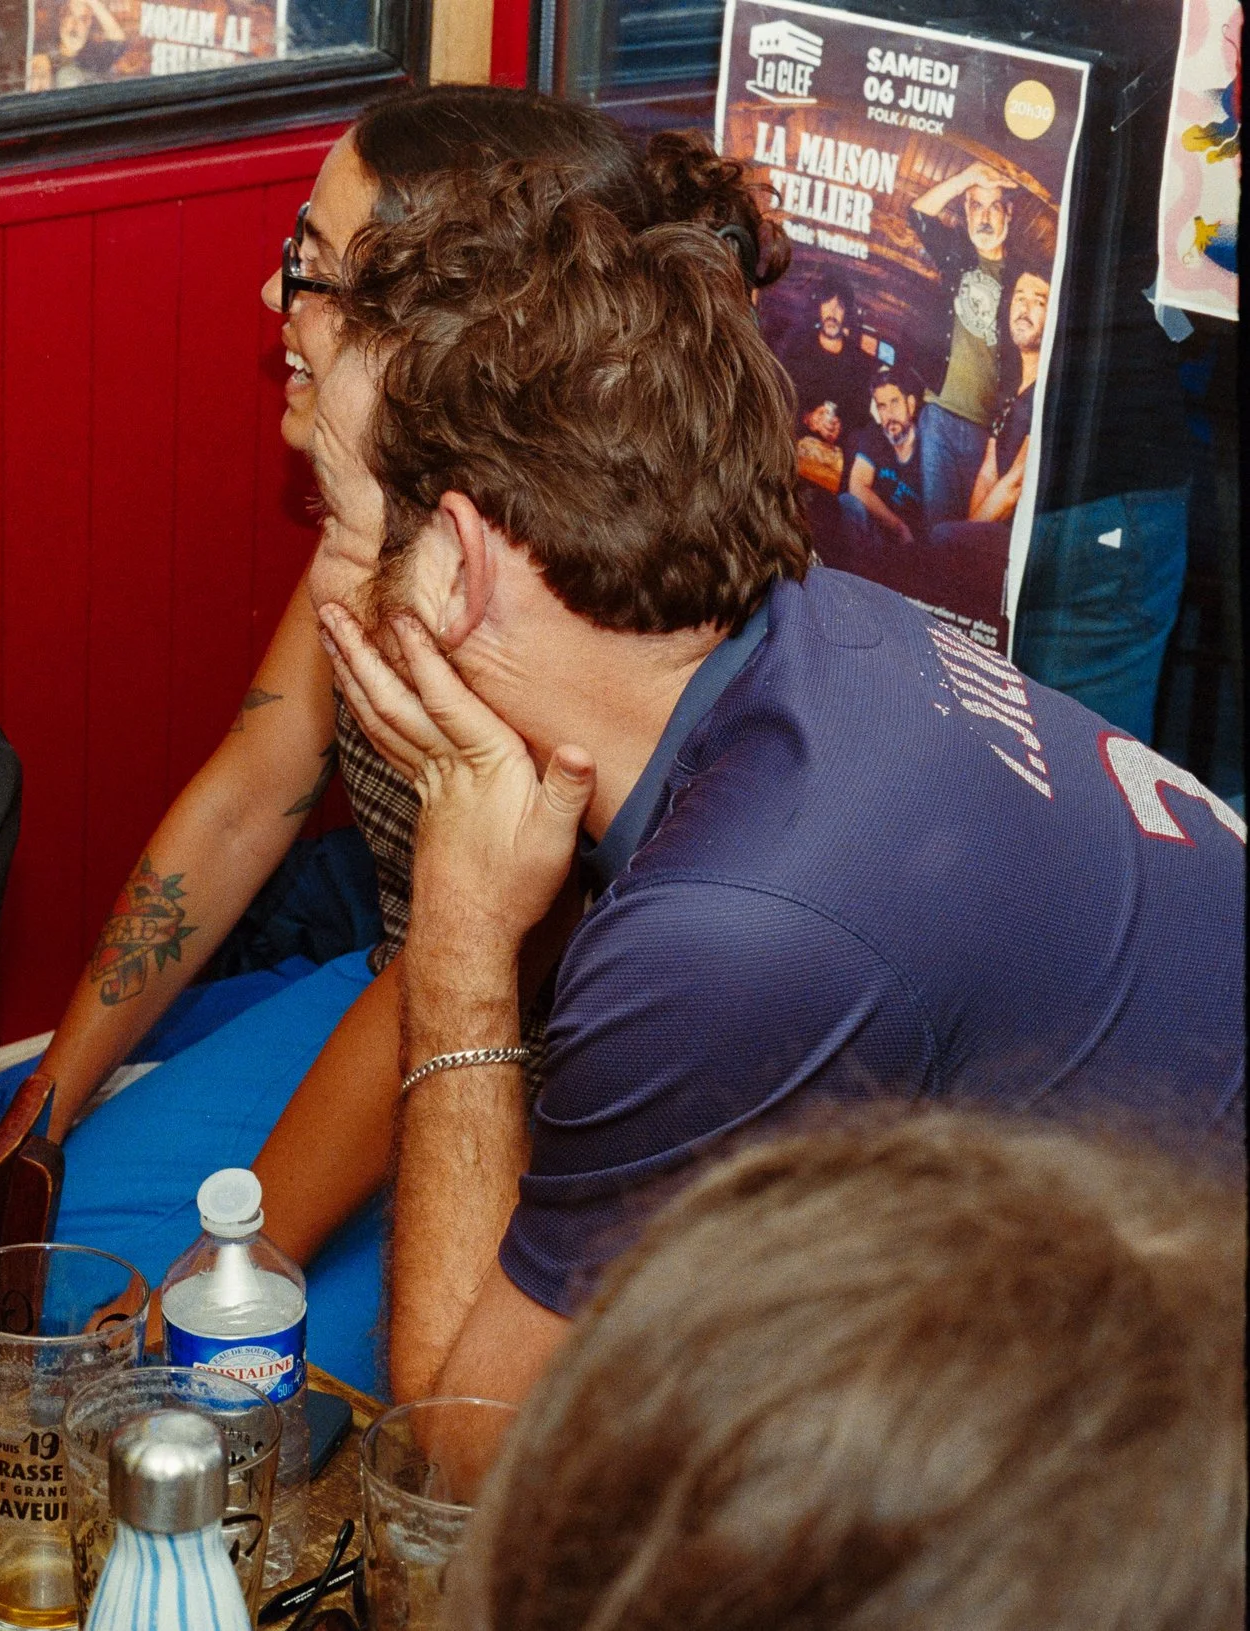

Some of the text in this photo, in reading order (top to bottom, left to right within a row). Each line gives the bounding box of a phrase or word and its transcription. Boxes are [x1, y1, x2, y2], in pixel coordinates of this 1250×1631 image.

[776, 58, 815, 97] CLEF
[866, 46, 959, 90] SAMEDI
[863, 76, 956, 119] 06 JUIN
[753, 121, 899, 196] LA MAISON
[769, 169, 874, 235] TELLIER
[213, 1346, 278, 1365] EAU DE SOURCE
[23, 1431, 60, 1460] 19
[14, 1484, 68, 1497] GRAND
